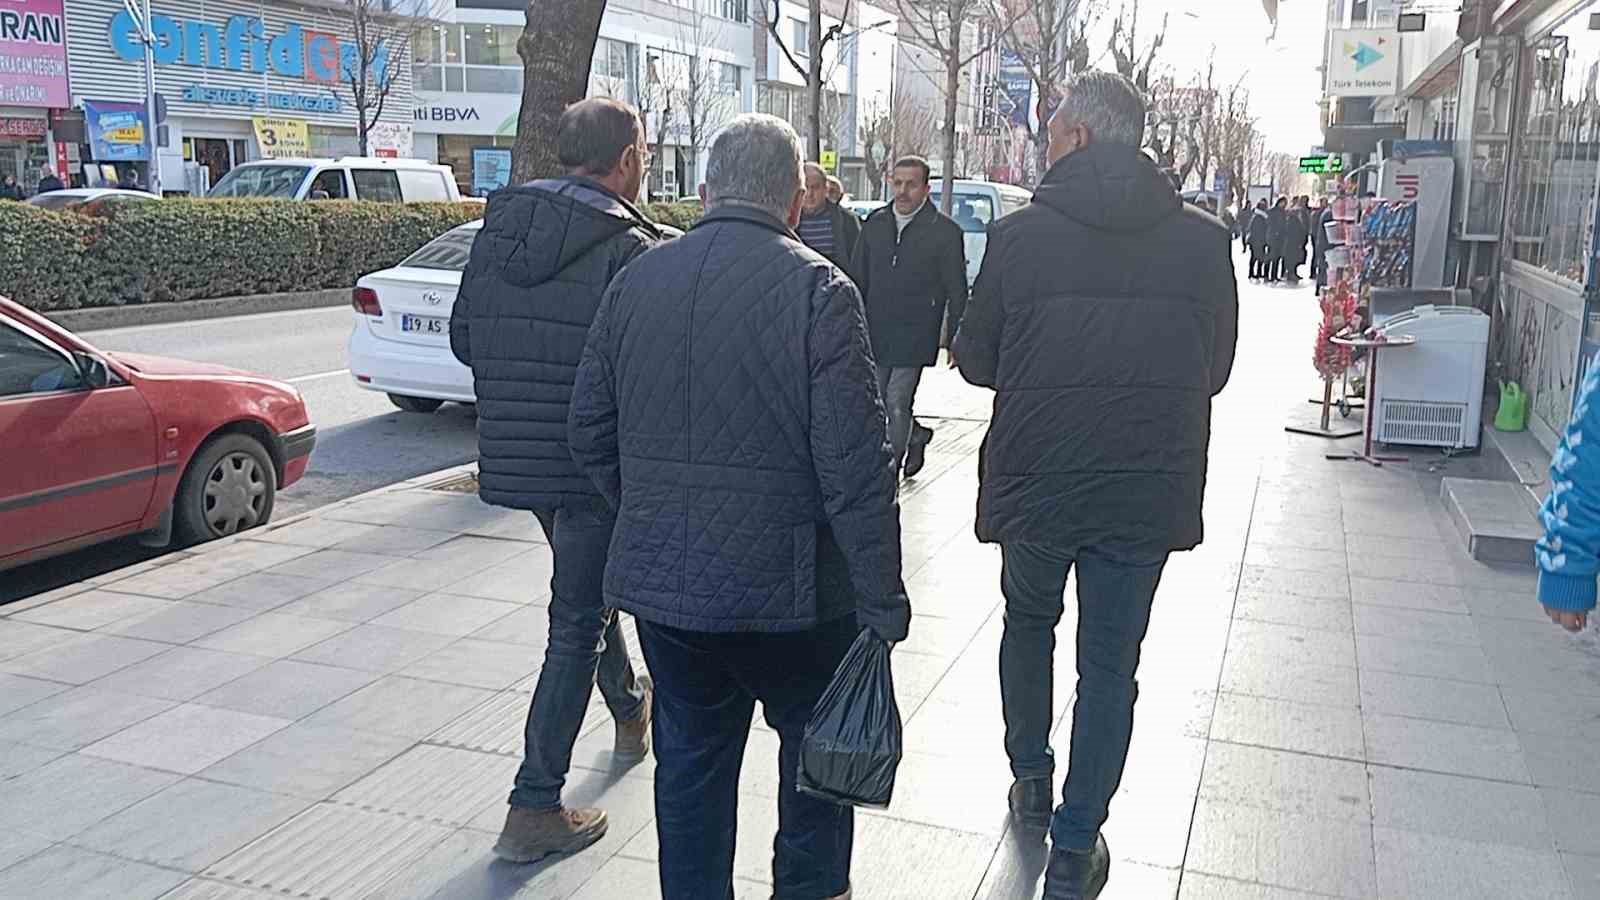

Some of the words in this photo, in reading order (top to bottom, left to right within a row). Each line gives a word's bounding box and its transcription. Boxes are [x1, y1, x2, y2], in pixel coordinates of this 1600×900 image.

[1, 11, 60, 43] RAN
[432, 107, 480, 120] BBVA
[261, 128, 277, 146] 3
[409, 318, 421, 331] 19
[428, 319, 442, 333] AS
